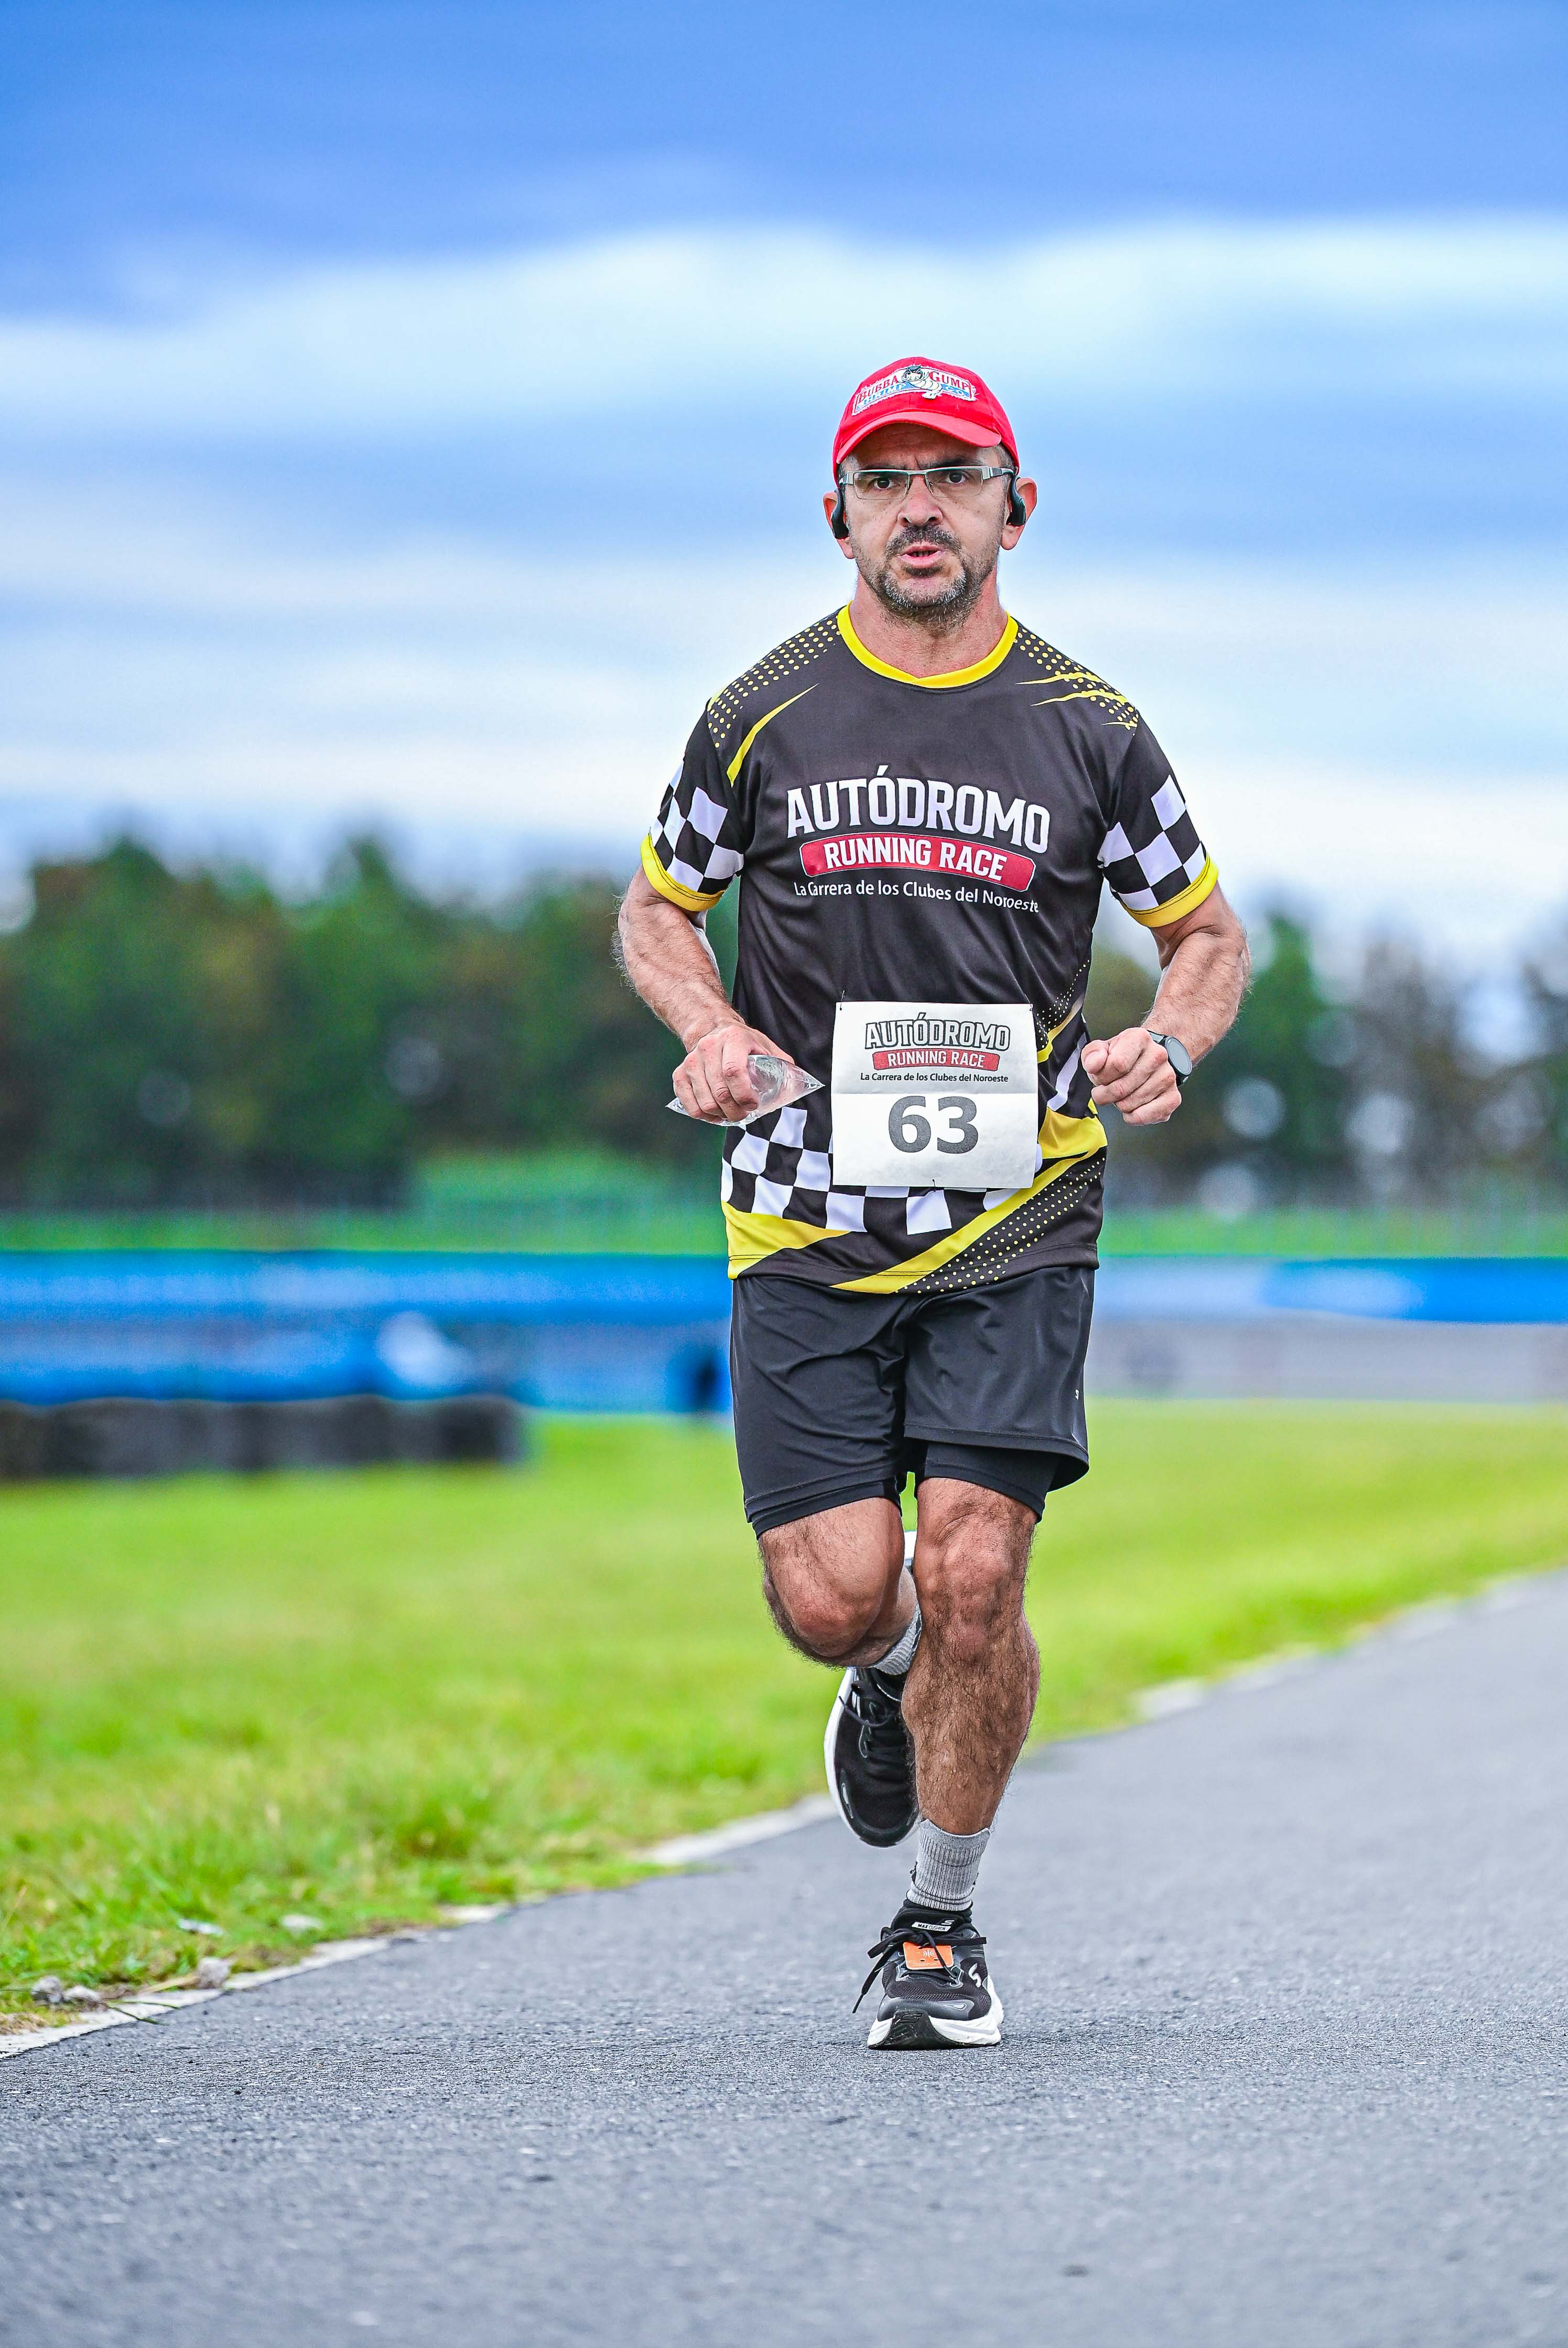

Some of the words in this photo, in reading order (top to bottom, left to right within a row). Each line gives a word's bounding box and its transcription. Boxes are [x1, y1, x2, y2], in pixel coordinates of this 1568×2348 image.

[858, 375, 899, 404] BUBBA
[929, 371, 969, 390] GUMP
[787, 765, 1050, 854] AUTÓDROMO
[824, 837, 932, 870] RUNNING
[938, 842, 1008, 881] RACE
[794, 882, 807, 896] La
[808, 881, 851, 896] Carrera
[856, 880, 874, 895] de
[878, 880, 899, 896] los
[903, 881, 951, 900] Clubes
[955, 887, 978, 902] del
[982, 890, 1039, 913] Noroeste
[865, 1012, 1011, 1051] AUTÓDROMO
[872, 1073, 902, 1081] Carrera
[904, 1073, 915, 1081] de
[916, 1073, 928, 1081] los
[930, 1073, 957, 1082] Clubes
[888, 1051, 946, 1067] RUNNING
[951, 1051, 986, 1068] RACE
[888, 1095, 978, 1154] 63
